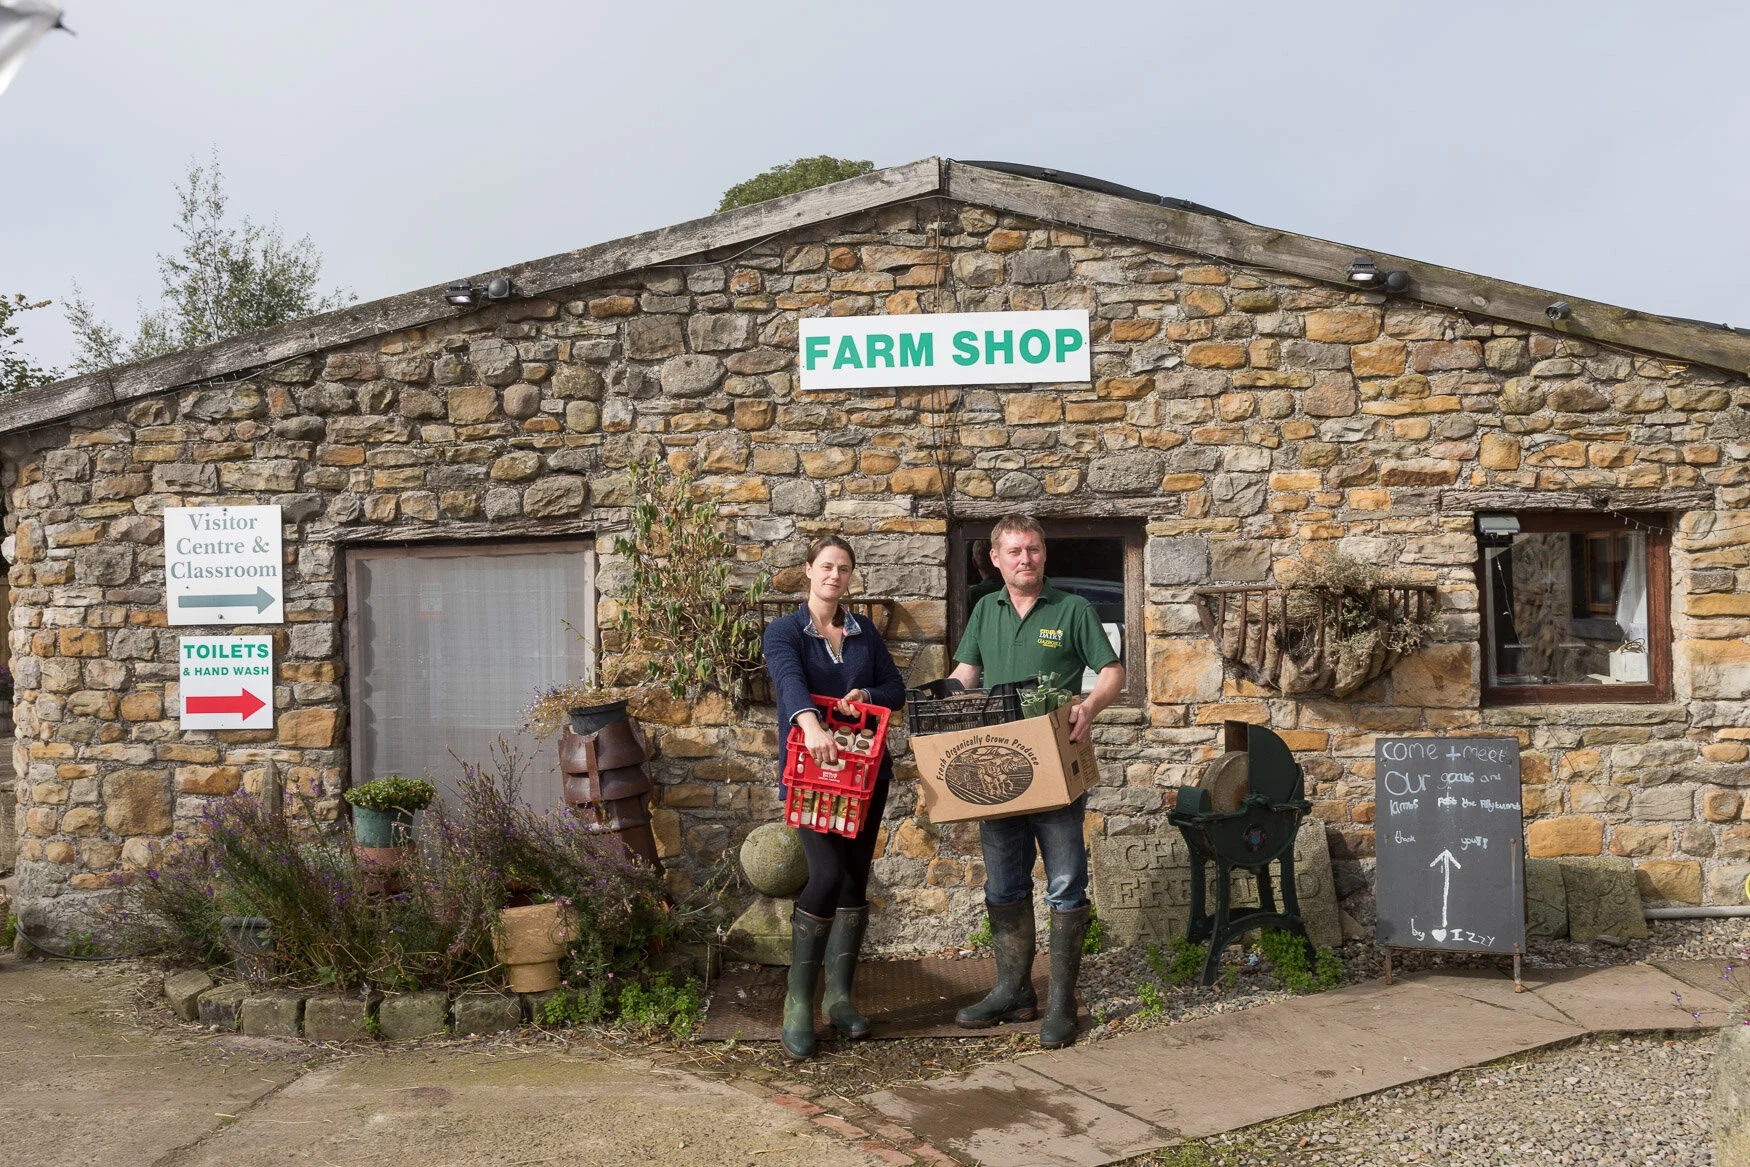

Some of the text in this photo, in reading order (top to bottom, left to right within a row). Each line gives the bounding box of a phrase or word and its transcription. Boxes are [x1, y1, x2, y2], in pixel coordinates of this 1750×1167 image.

[805, 328, 1083, 371] FARM SHOP
[187, 512, 258, 531] Visitor
[176, 535, 270, 555] Centre &
[170, 561, 277, 579] Classroom
[183, 643, 269, 659] TOILETS
[182, 666, 269, 676] & HAND WASH
[936, 734, 1040, 781] Fresh Organically Grown Produce
